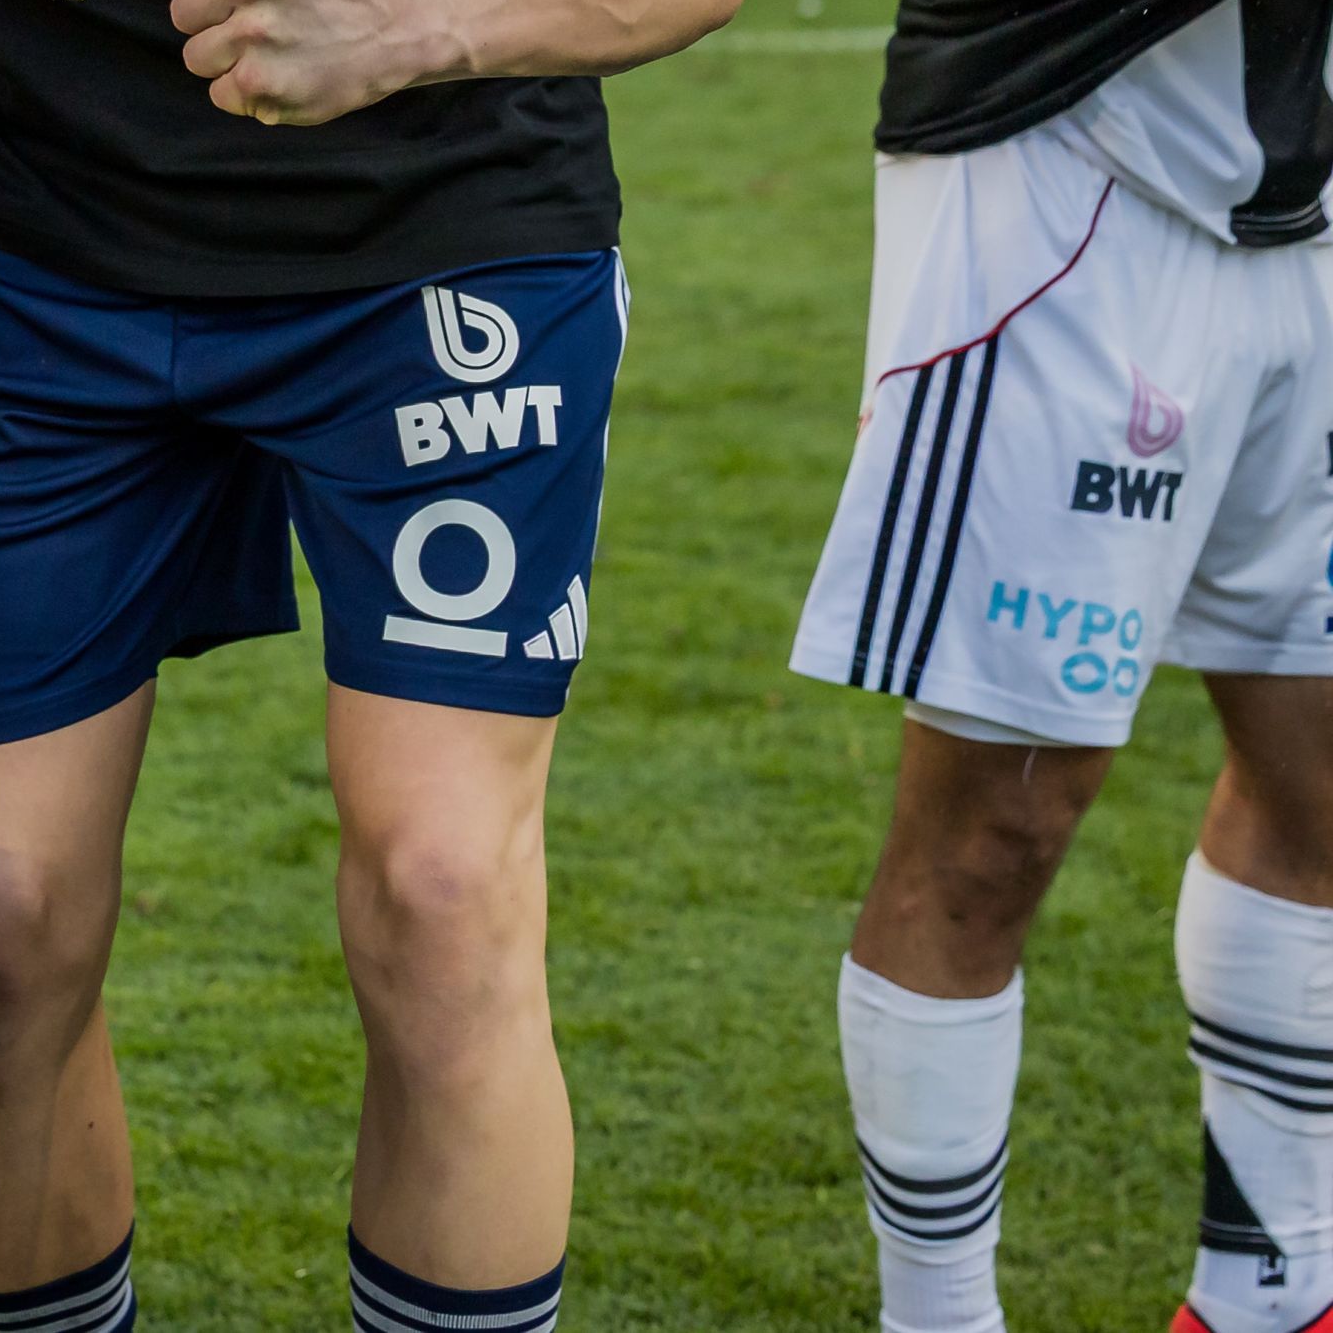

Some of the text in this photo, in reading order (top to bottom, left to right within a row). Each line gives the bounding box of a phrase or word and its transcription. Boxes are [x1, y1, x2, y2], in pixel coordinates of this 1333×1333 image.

[394, 384, 562, 467] BWT
[1070, 459, 1183, 522] BWT
[986, 580, 1143, 652] HYPO
[1060, 651, 1141, 697] OO
